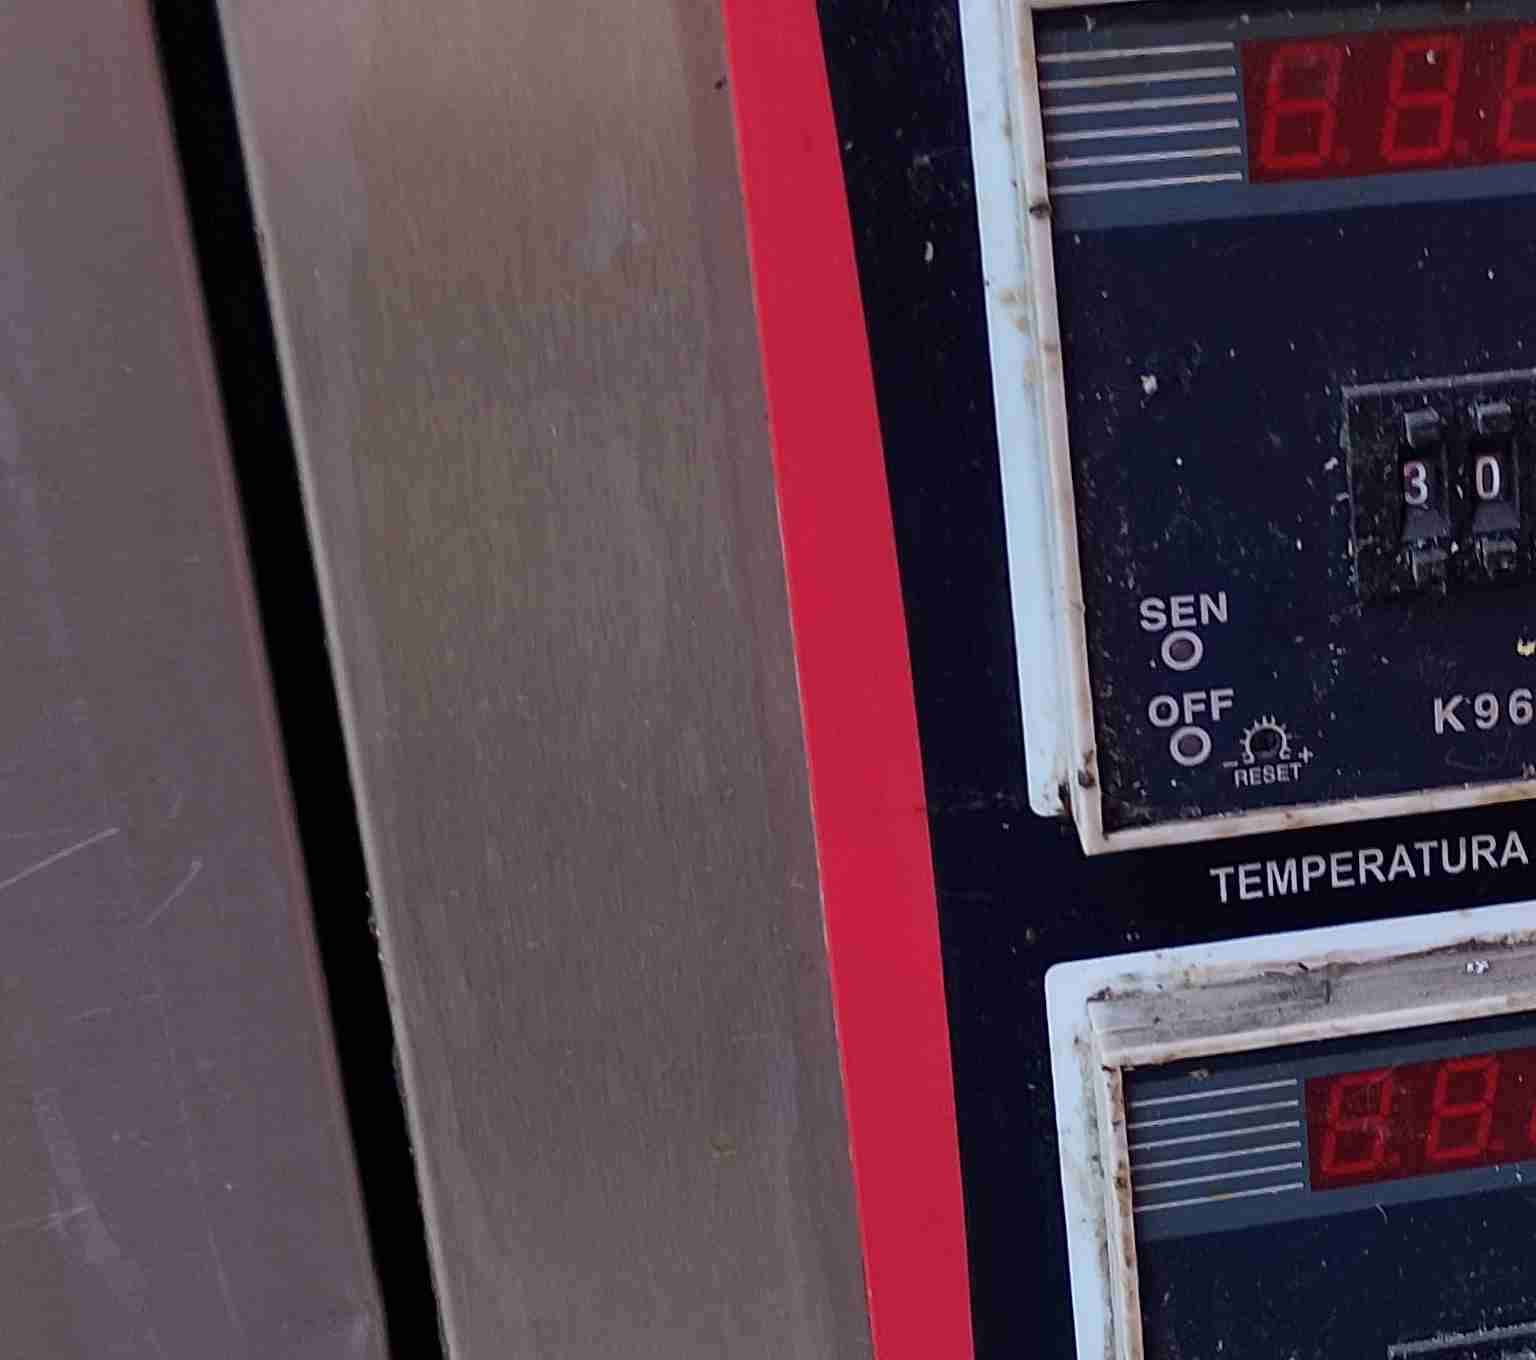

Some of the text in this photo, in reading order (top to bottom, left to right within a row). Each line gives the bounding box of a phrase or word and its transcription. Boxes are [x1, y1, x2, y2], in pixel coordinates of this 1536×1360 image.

[1138, 590, 1230, 632] SEN
[1146, 687, 1235, 728] OFF
[1232, 759, 1304, 787] RESET
[1209, 830, 1526, 907] TEMPERATURA
